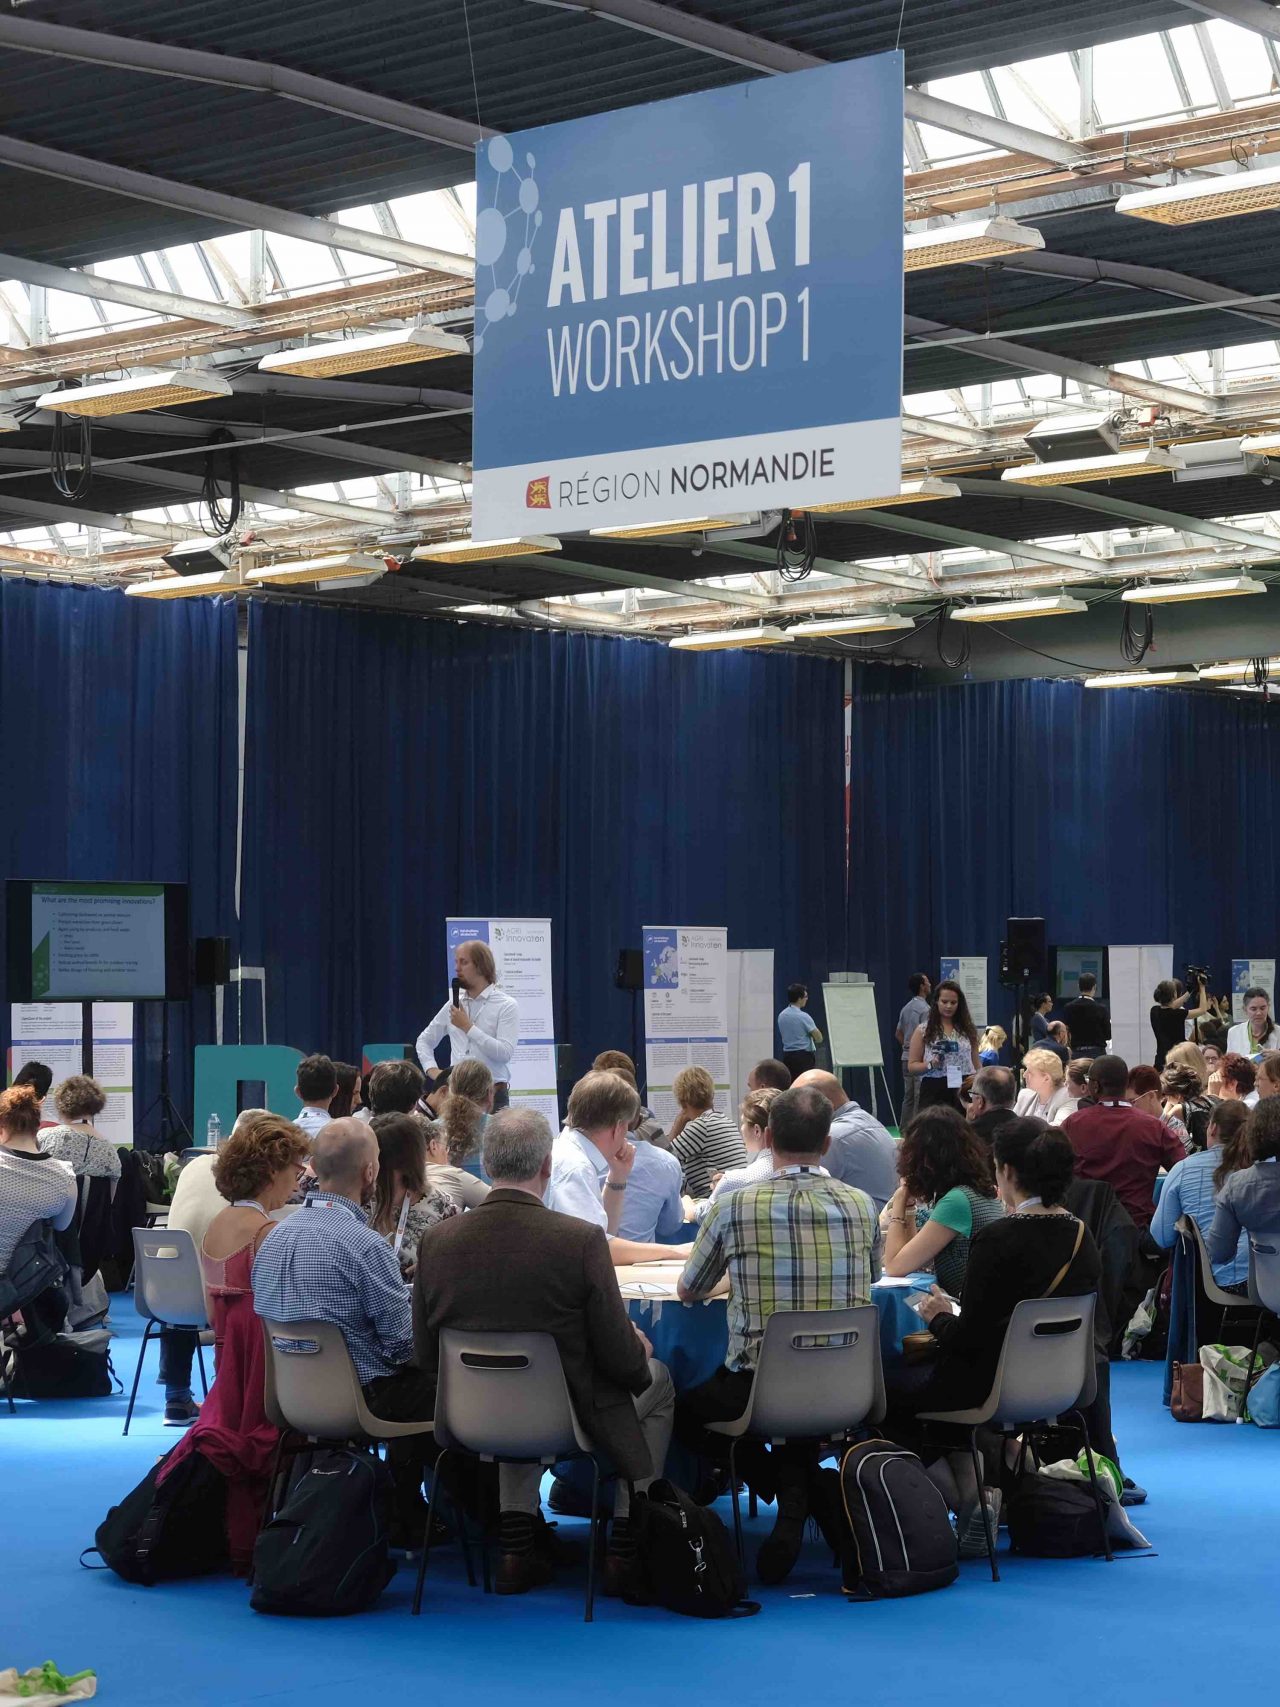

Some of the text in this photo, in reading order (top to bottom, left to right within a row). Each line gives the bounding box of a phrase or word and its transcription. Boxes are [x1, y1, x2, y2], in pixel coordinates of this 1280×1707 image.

[547, 162, 811, 308] ATELIER 1
[547, 286, 811, 398] WORKSHOP 1
[559, 448, 835, 508] RÉGION NORMANDIE
